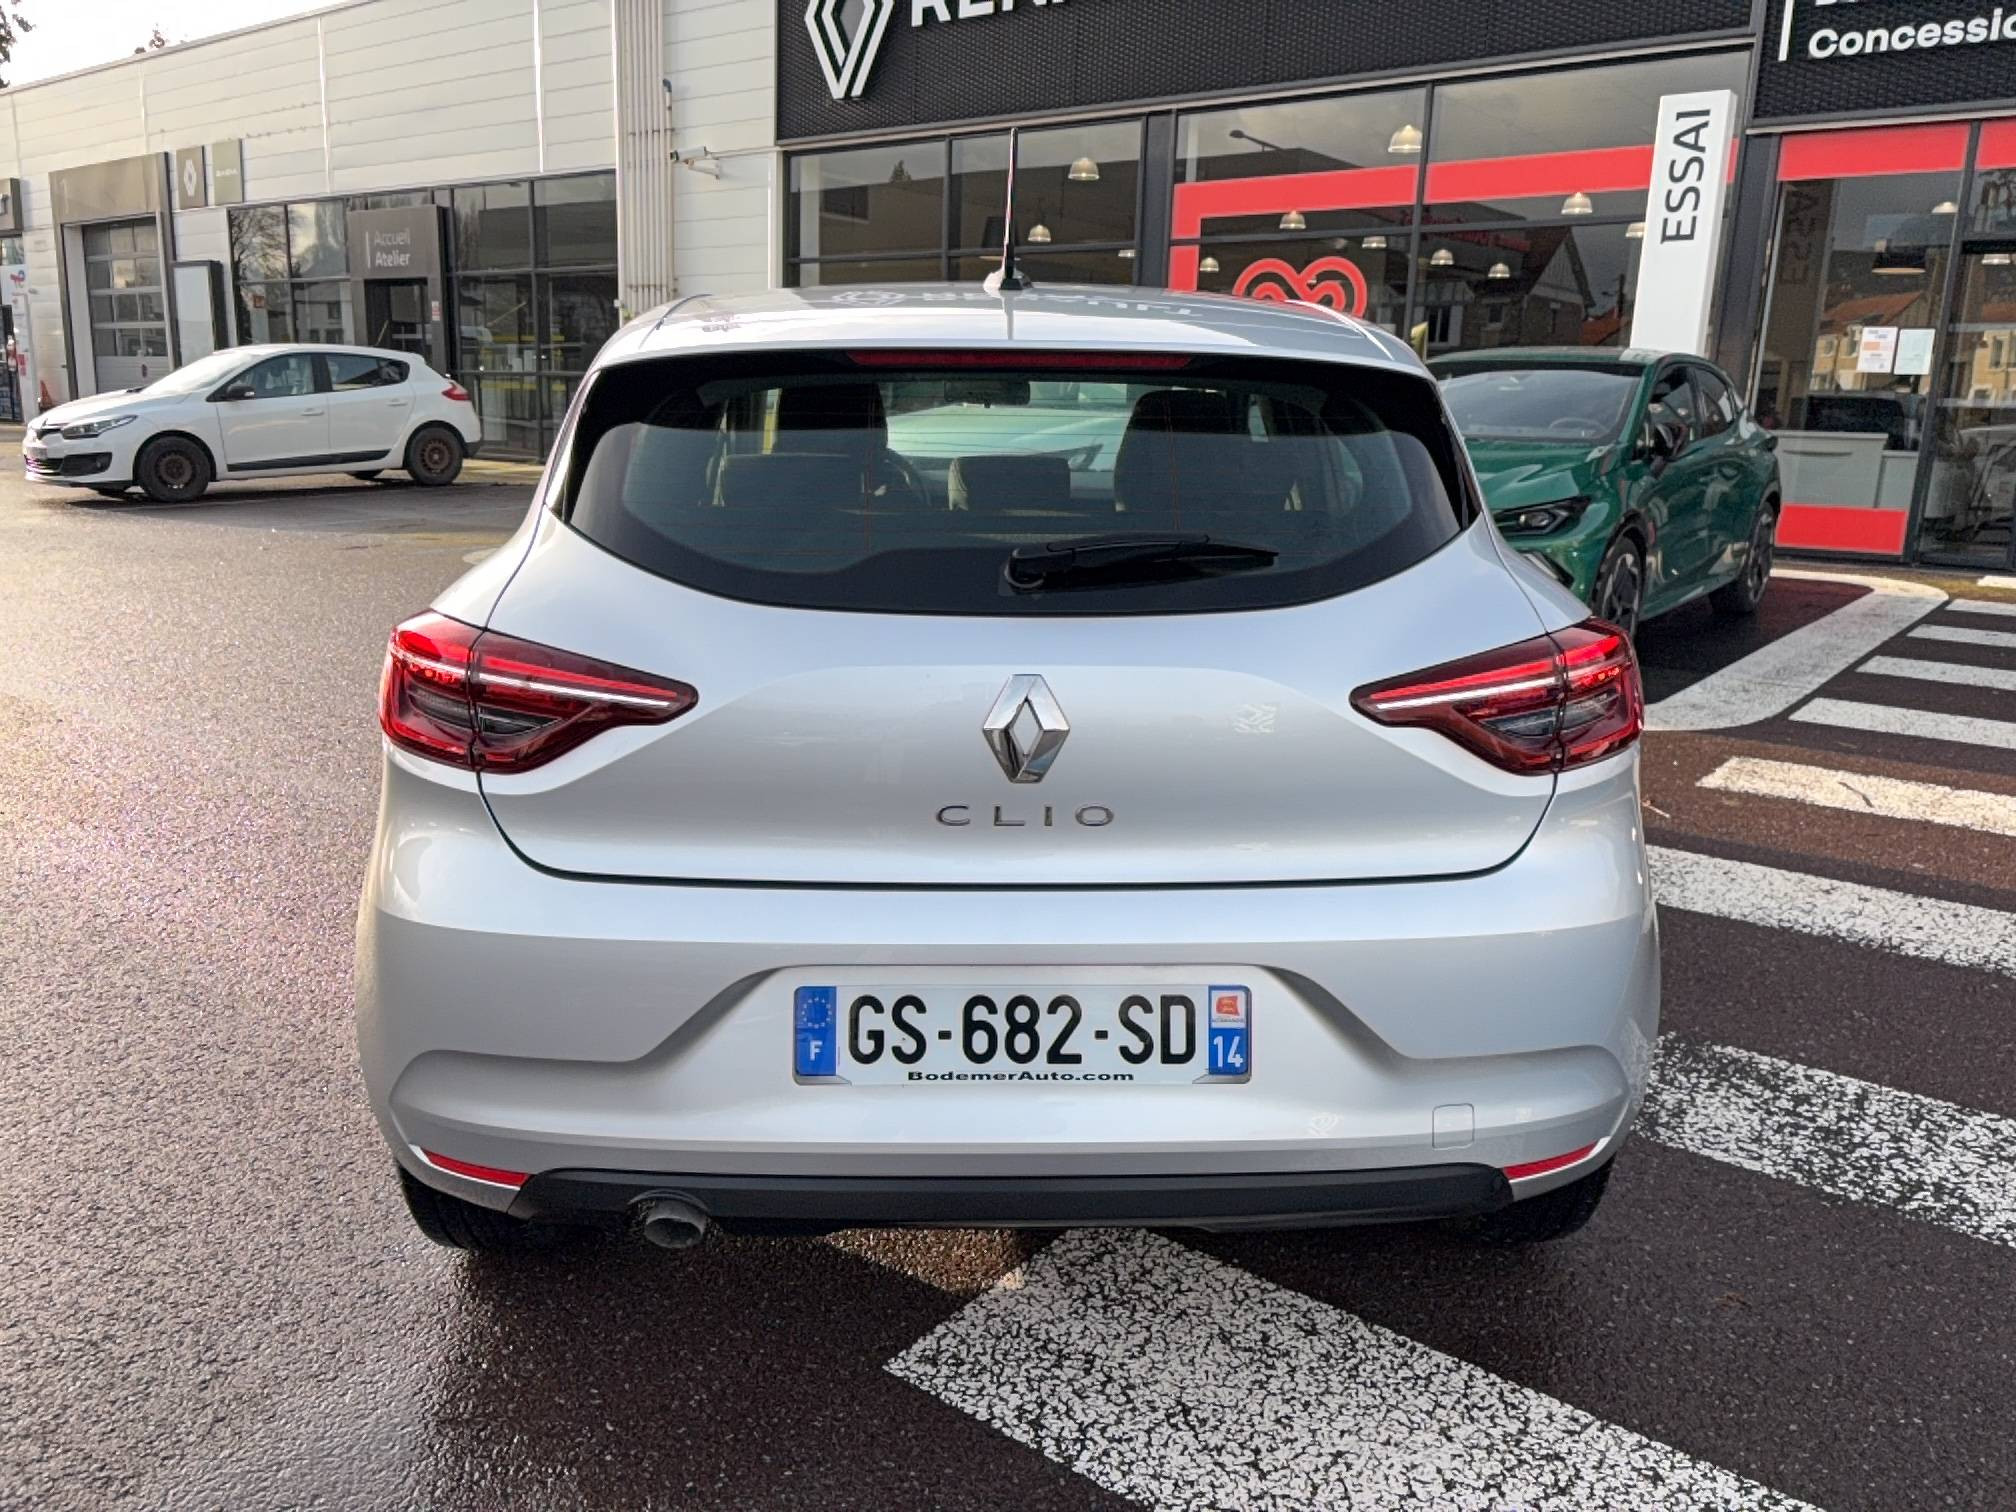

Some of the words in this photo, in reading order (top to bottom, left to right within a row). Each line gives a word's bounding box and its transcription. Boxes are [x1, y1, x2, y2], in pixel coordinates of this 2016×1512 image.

[1660, 109, 1711, 244] ESSAI
[374, 228, 410, 246] Accueil
[375, 249, 411, 267] Atelier
[936, 805, 1114, 826] CLIO
[848, 994, 1196, 1065] GS-682-SD
[809, 1040, 823, 1061] F
[1213, 1035, 1244, 1068] 14
[907, 1070, 1134, 1081] BodemerAuto.com
